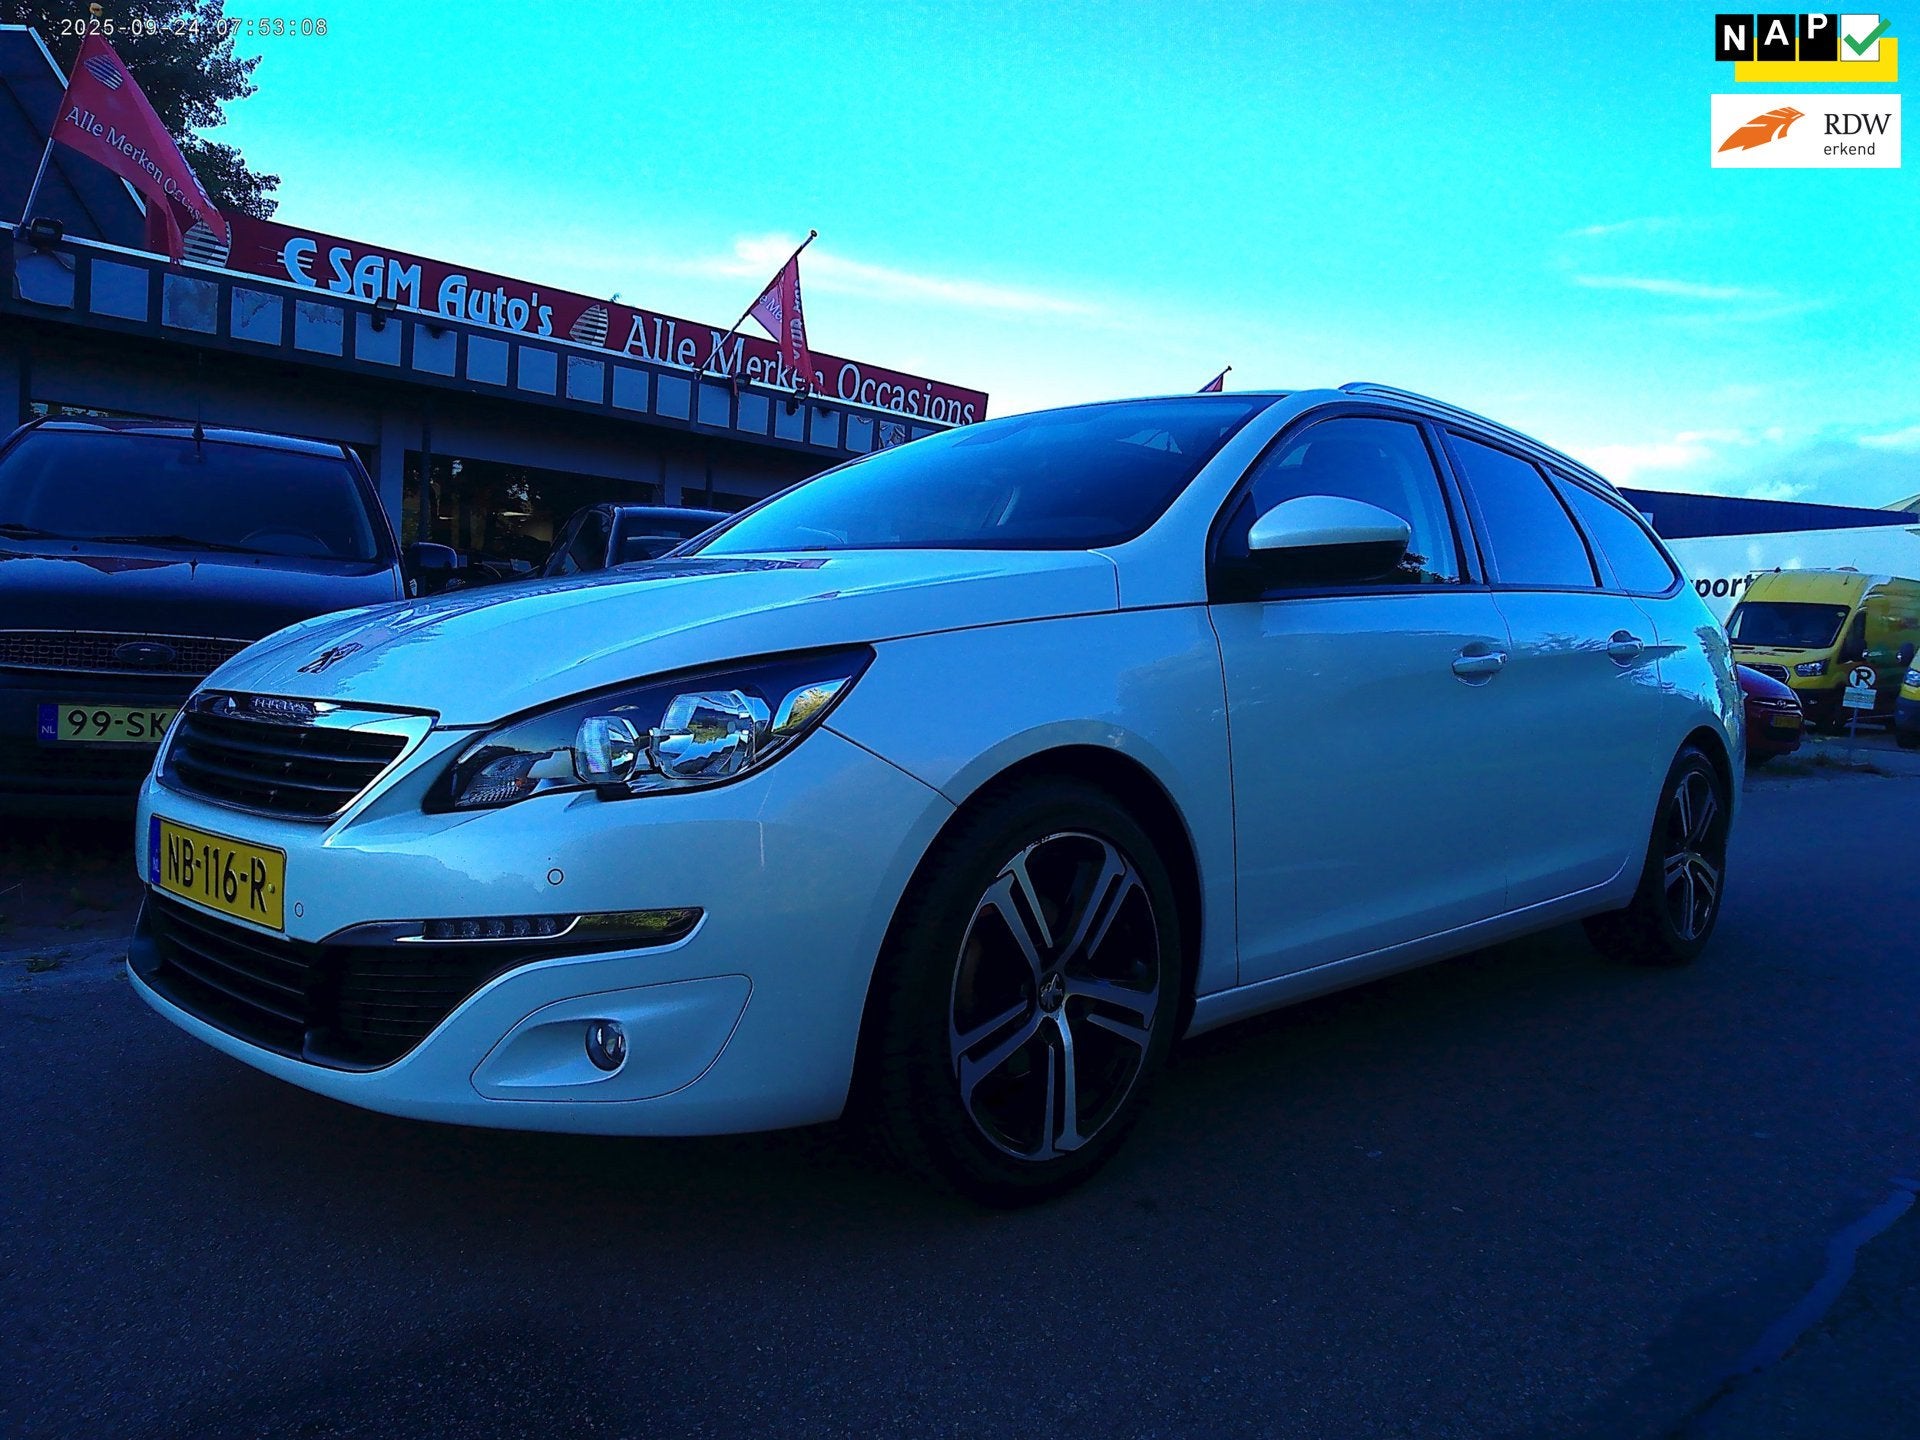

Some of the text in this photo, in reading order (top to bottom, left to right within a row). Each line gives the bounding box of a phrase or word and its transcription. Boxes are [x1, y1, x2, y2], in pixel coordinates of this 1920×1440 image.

[64, 106, 104, 138] Alle
[105, 126, 164, 186] Merken
[438, 274, 553, 336] Auto's
[623, 314, 975, 427] Alle Merken Occasions
[1690, 574, 1755, 598] port
[41, 725, 56, 735] NL
[67, 709, 167, 738] 99-SK
[168, 832, 268, 914] NB-116-R
